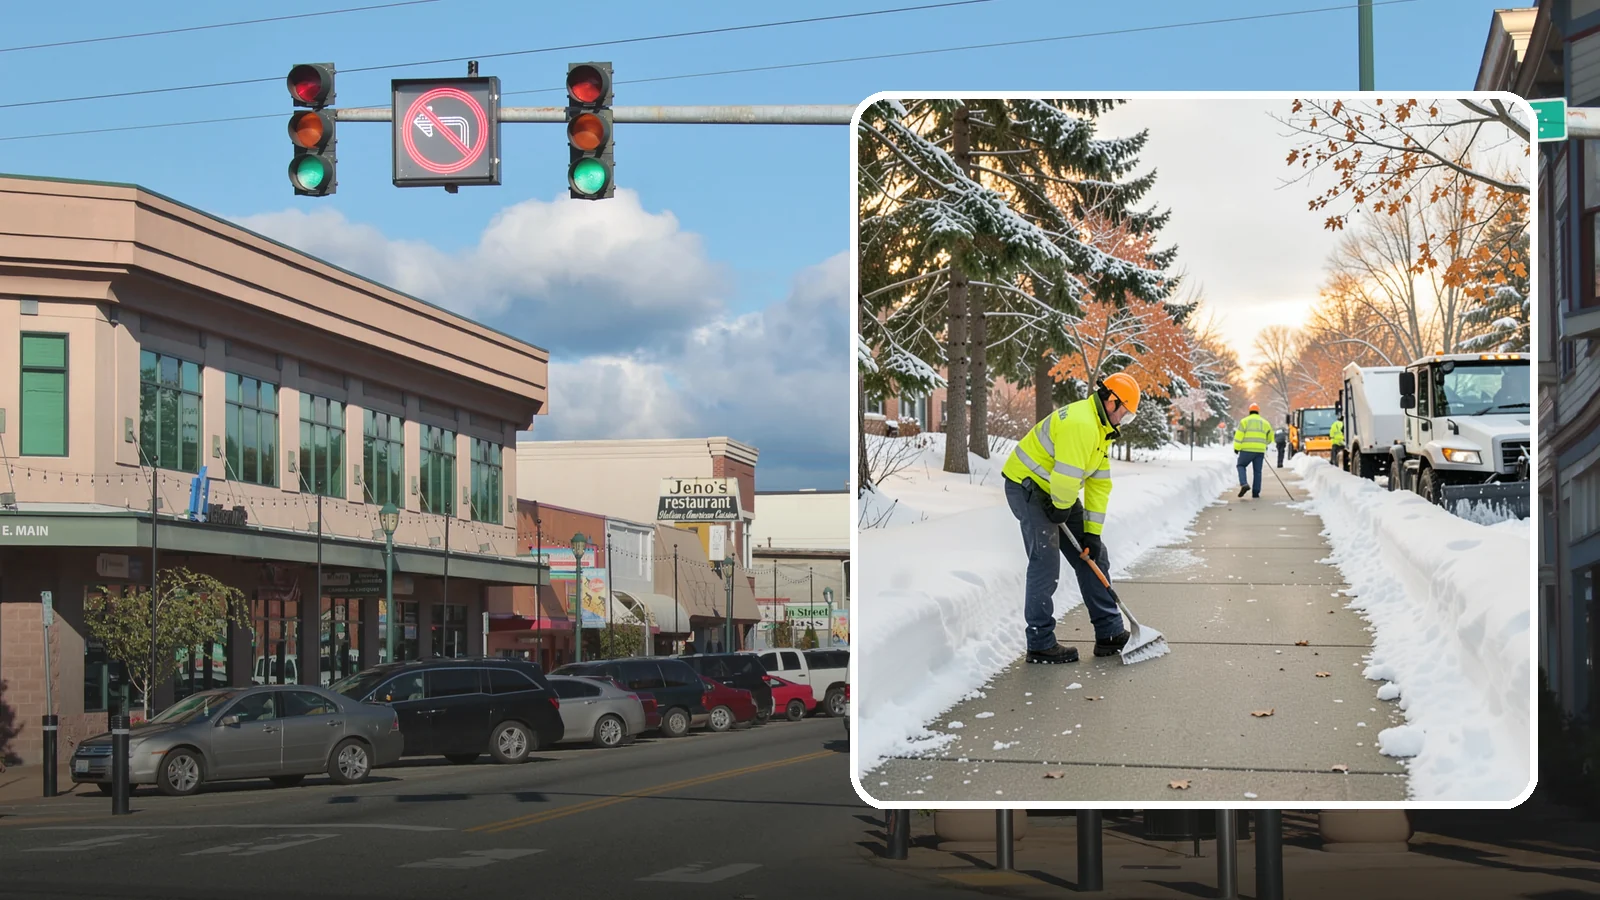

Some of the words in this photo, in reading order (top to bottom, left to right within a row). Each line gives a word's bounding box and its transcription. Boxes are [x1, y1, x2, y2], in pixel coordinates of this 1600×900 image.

[670, 480, 727, 494] Jeno's
[665, 496, 731, 509] restaurant
[658, 509, 682, 519] Italian
[686, 509, 714, 519] American
[715, 509, 738, 519] Cuisine
[2, 525, 13, 536] E.
[15, 525, 49, 536] MAIN
[797, 607, 828, 617] Street
